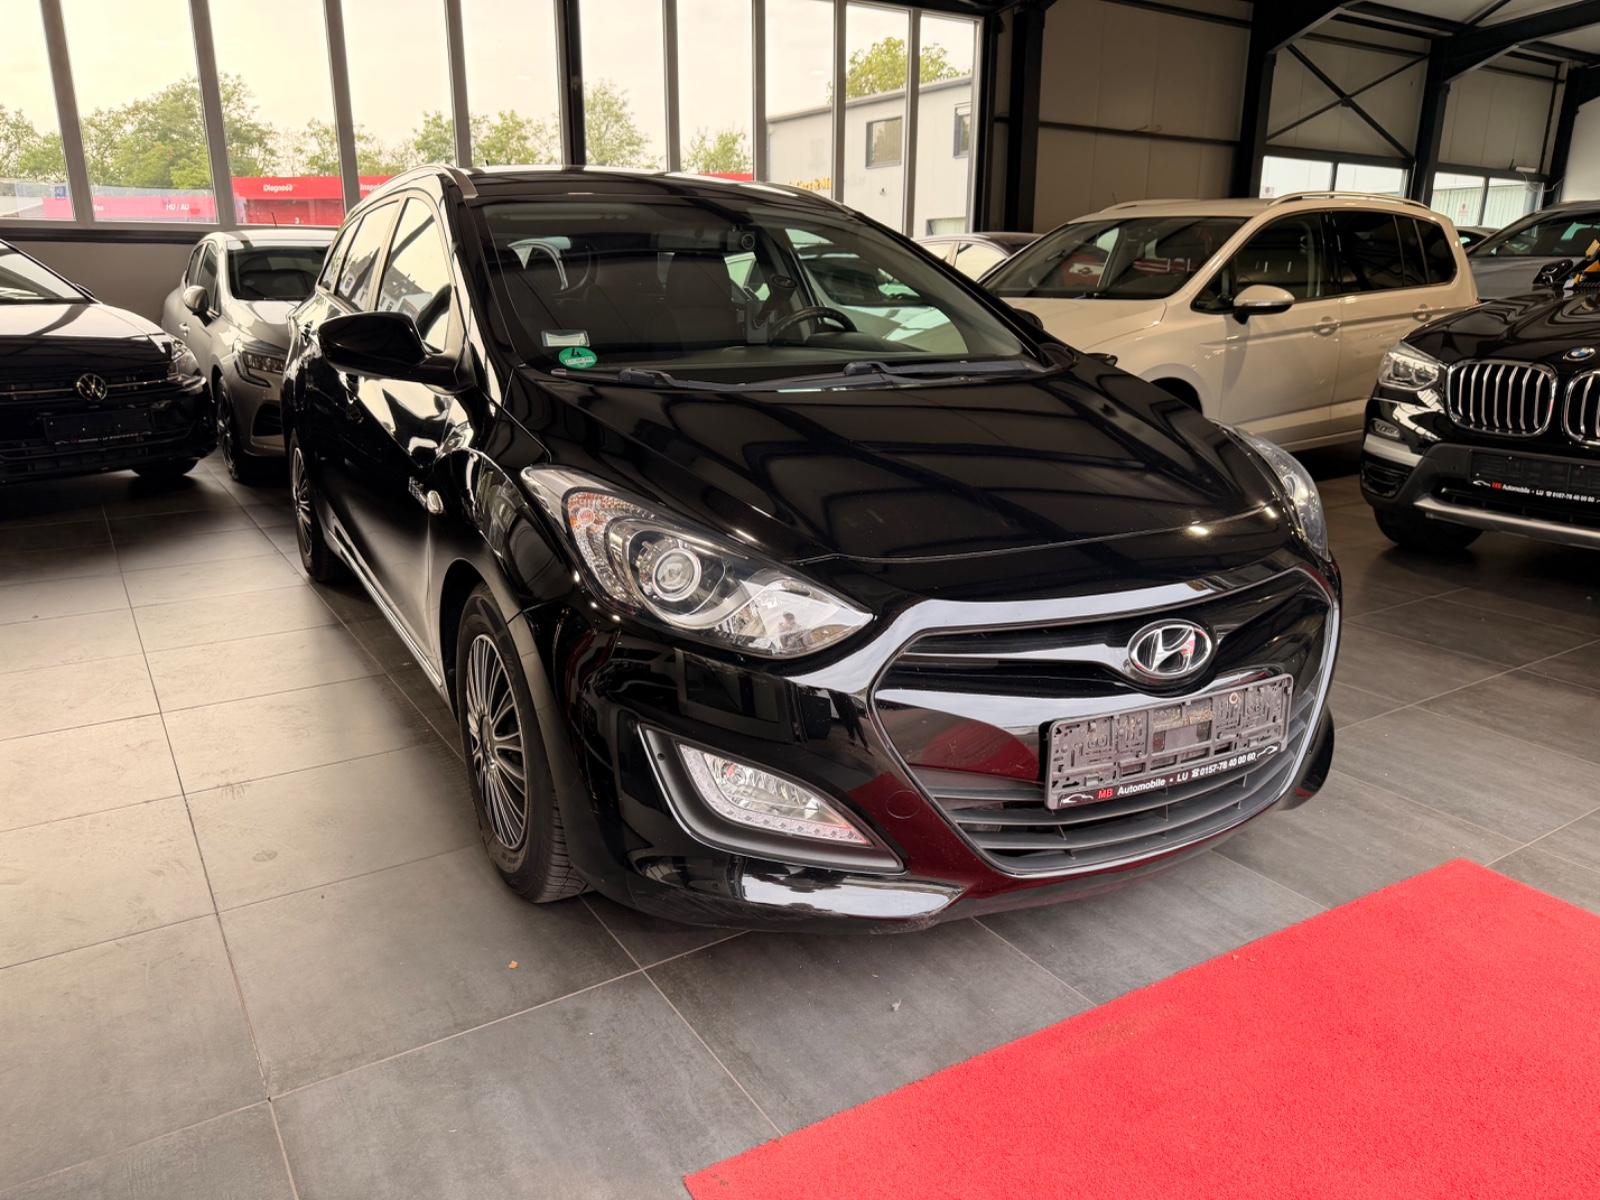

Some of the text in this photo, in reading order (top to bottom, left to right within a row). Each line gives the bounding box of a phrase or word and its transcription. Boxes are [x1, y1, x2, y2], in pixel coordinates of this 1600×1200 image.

[1098, 751, 1257, 800] MB Automobile LU 0157-78 40 00 60
